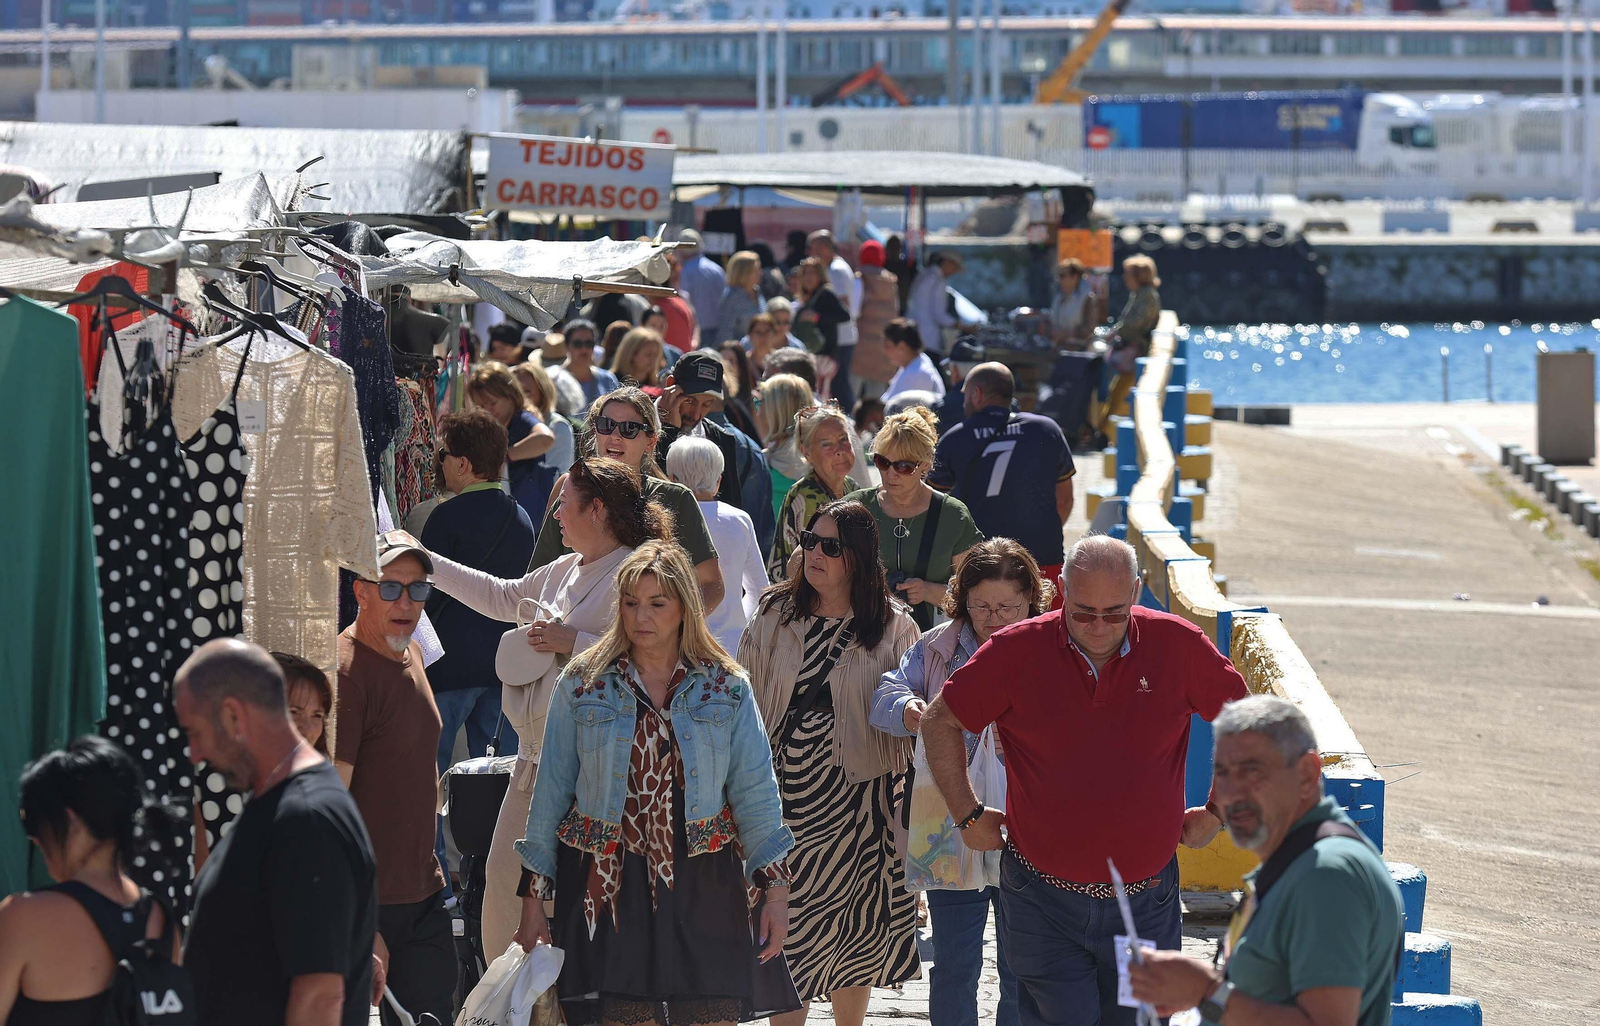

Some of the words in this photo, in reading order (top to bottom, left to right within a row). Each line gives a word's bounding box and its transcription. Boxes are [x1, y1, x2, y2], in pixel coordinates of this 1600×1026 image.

[519, 139, 645, 172] TEJIDOS
[497, 178, 659, 211] CARRASCO
[981, 440, 1017, 498] 7
